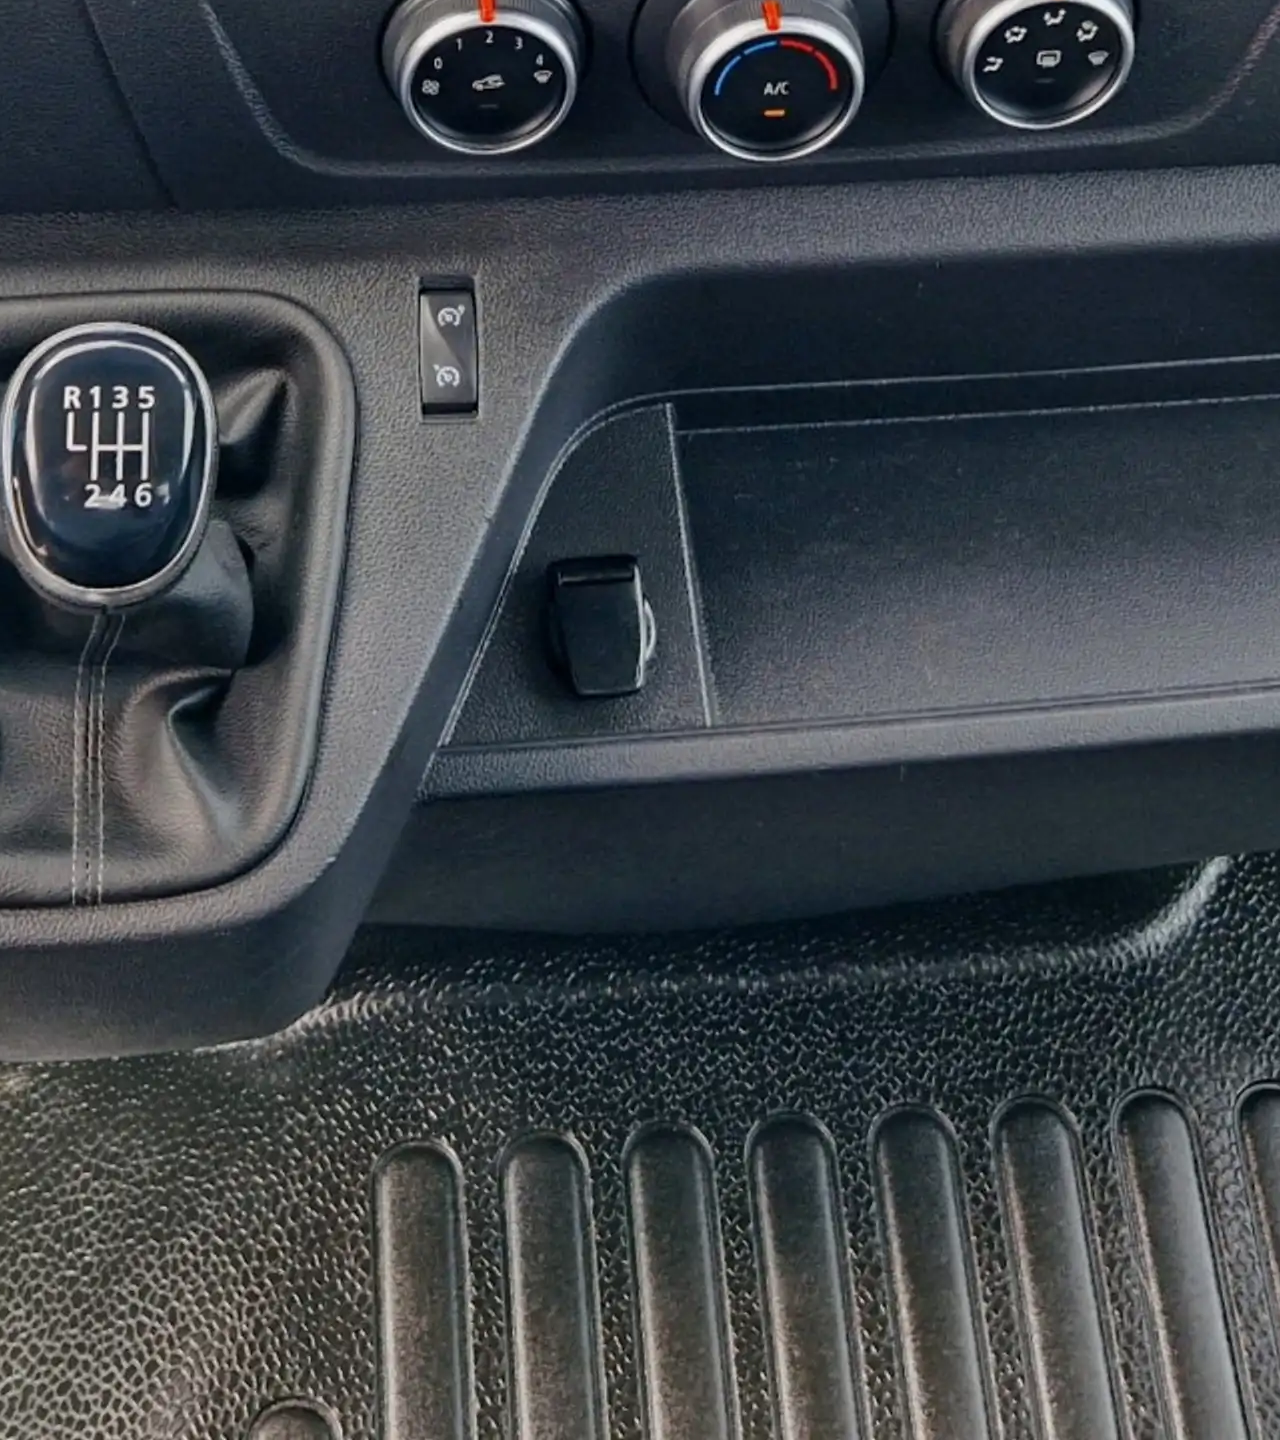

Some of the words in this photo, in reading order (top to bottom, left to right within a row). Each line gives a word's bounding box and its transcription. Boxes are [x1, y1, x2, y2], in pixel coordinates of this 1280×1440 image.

[455, 37, 463, 51] 1
[484, 30, 495, 44] 2
[514, 36, 524, 51] 3
[535, 53, 544, 67] 4
[763, 79, 791, 97] A/C
[63, 384, 82, 410] R
[88, 384, 102, 410] 1
[111, 384, 130, 410] 3
[137, 384, 156, 410] 5
[83, 483, 103, 509] 2
[107, 482, 128, 508] 4
[133, 481, 153, 509] 6
